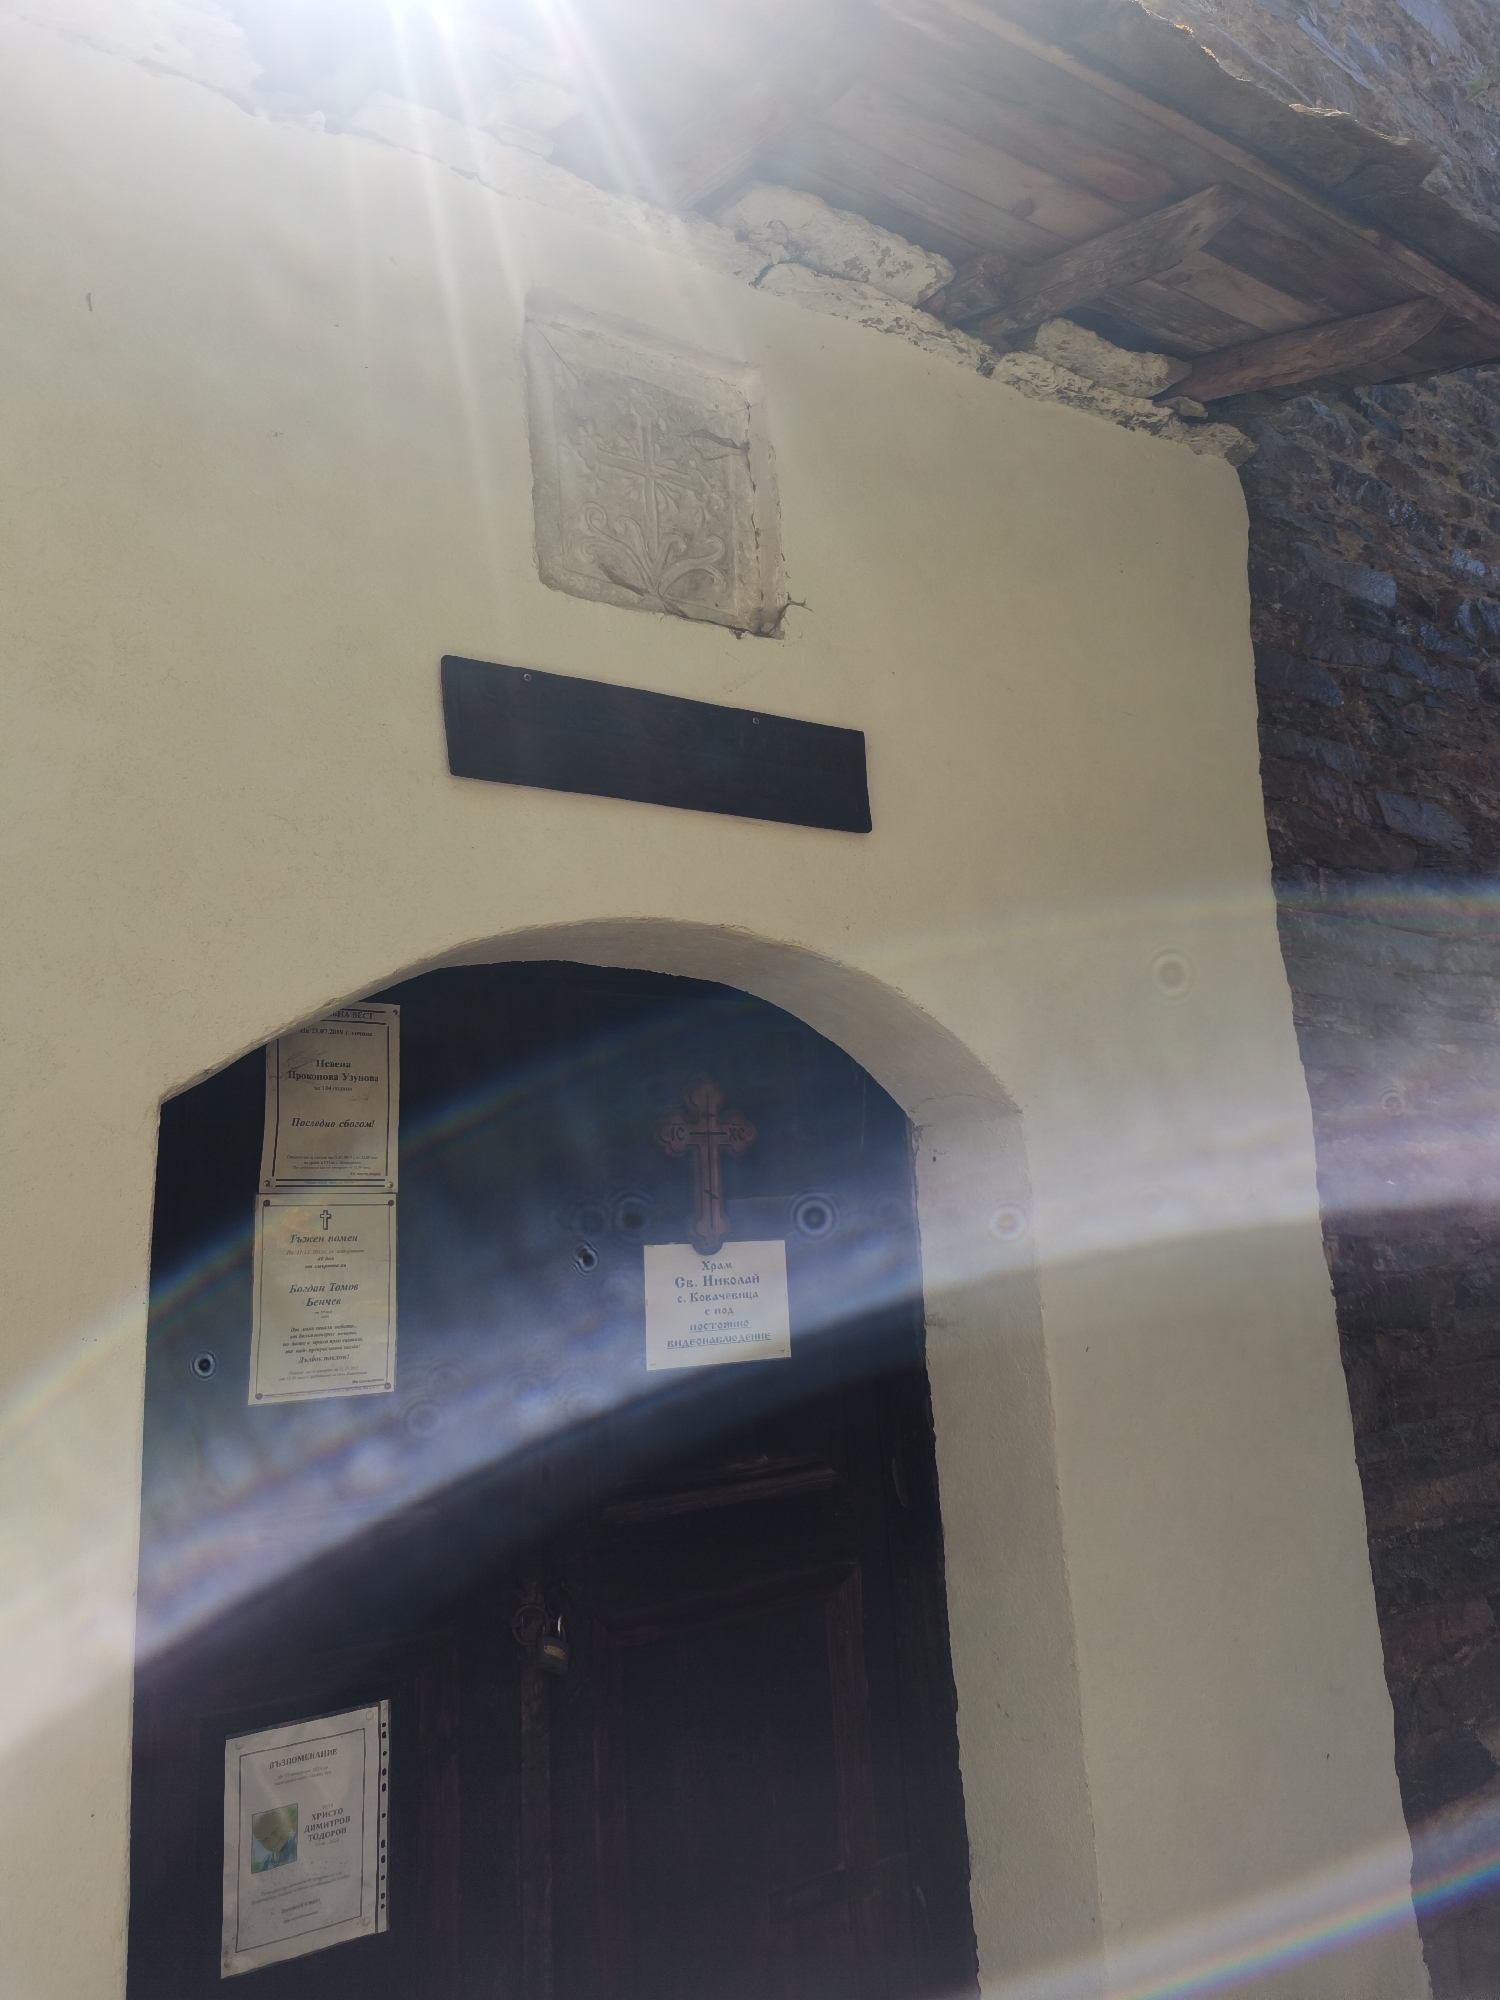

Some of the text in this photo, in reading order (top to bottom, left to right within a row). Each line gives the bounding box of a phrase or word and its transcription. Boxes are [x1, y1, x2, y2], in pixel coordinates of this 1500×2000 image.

[352, 1011, 374, 1019] ВЕСТ
[316, 1060, 351, 1068] Невена
[288, 1070, 379, 1083] Прокопова Узунова
[291, 1118, 375, 1128] Последно сбогом!
[290, 1234, 324, 1243] Тъжен
[701, 1260, 733, 1273] Храм
[674, 1273, 760, 1289] Св. Николай
[289, 1282, 359, 1294] Богдан Томов
[690, 1291, 759, 1303] Ковачевица
[269, 1748, 338, 1769] ВЪЗПОМЕНАНИЕ
[311, 1808, 344, 1821] ХРИСТО
[304, 1816, 351, 1833] ДИМИТРОВ
[308, 1827, 347, 1841] ТОДОРОВ
